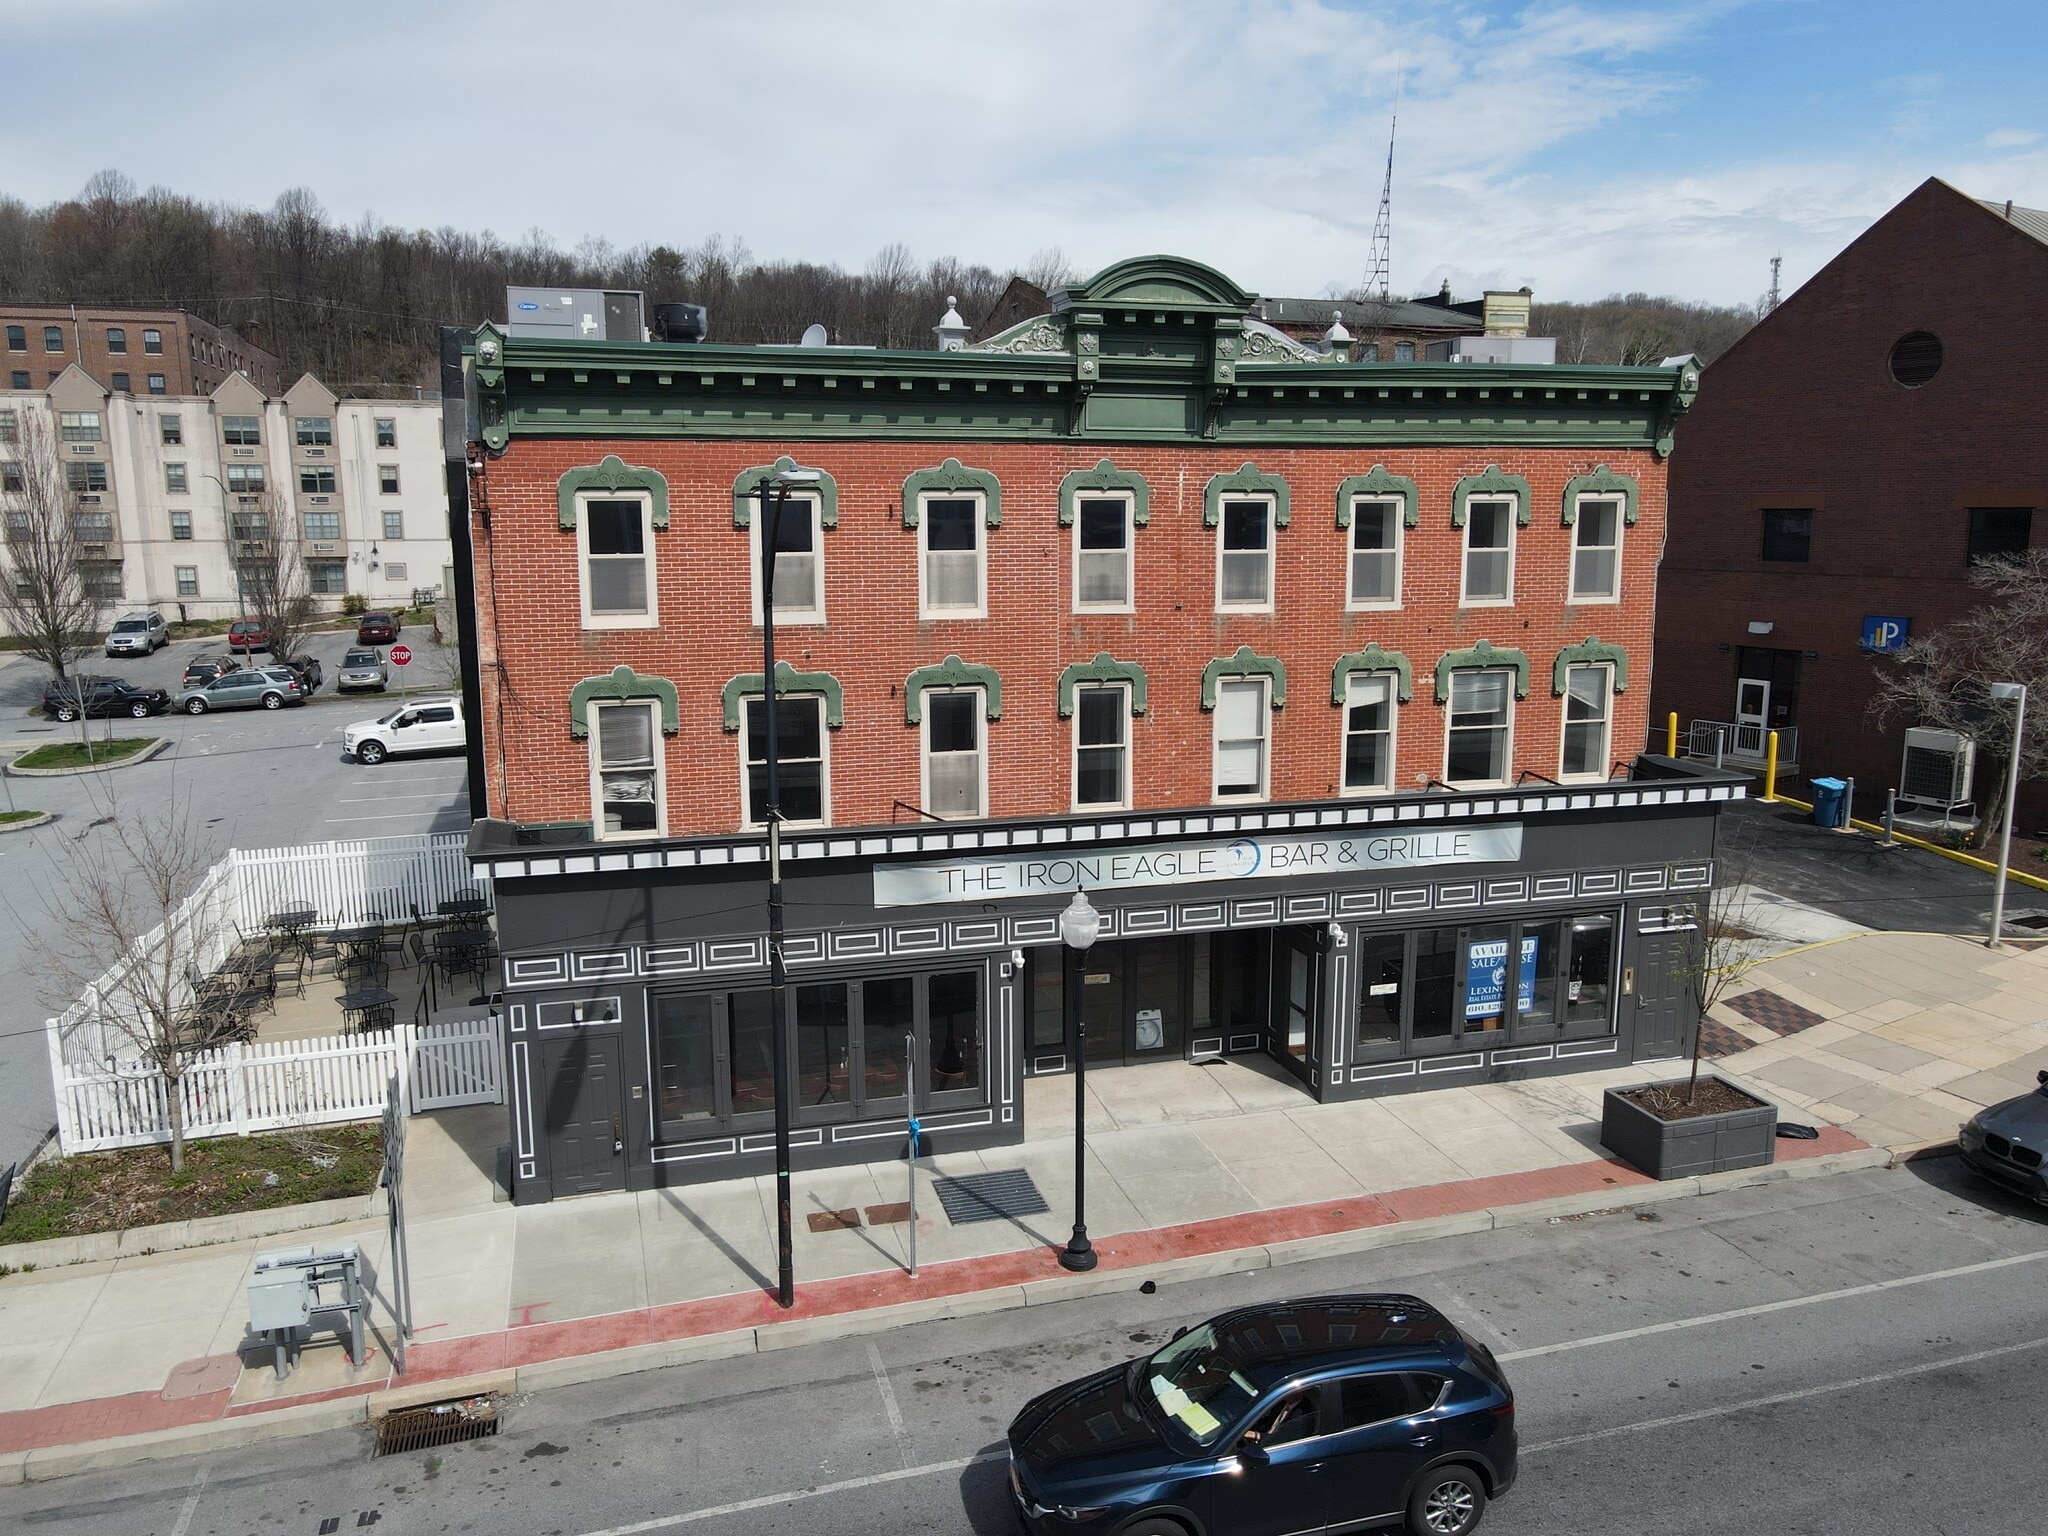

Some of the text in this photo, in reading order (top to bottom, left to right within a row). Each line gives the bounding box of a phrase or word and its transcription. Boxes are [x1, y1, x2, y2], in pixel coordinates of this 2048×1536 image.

[391, 652, 411, 660] STOP
[938, 834, 1472, 893] THE IRON EAGLE BAR & GRILLE
